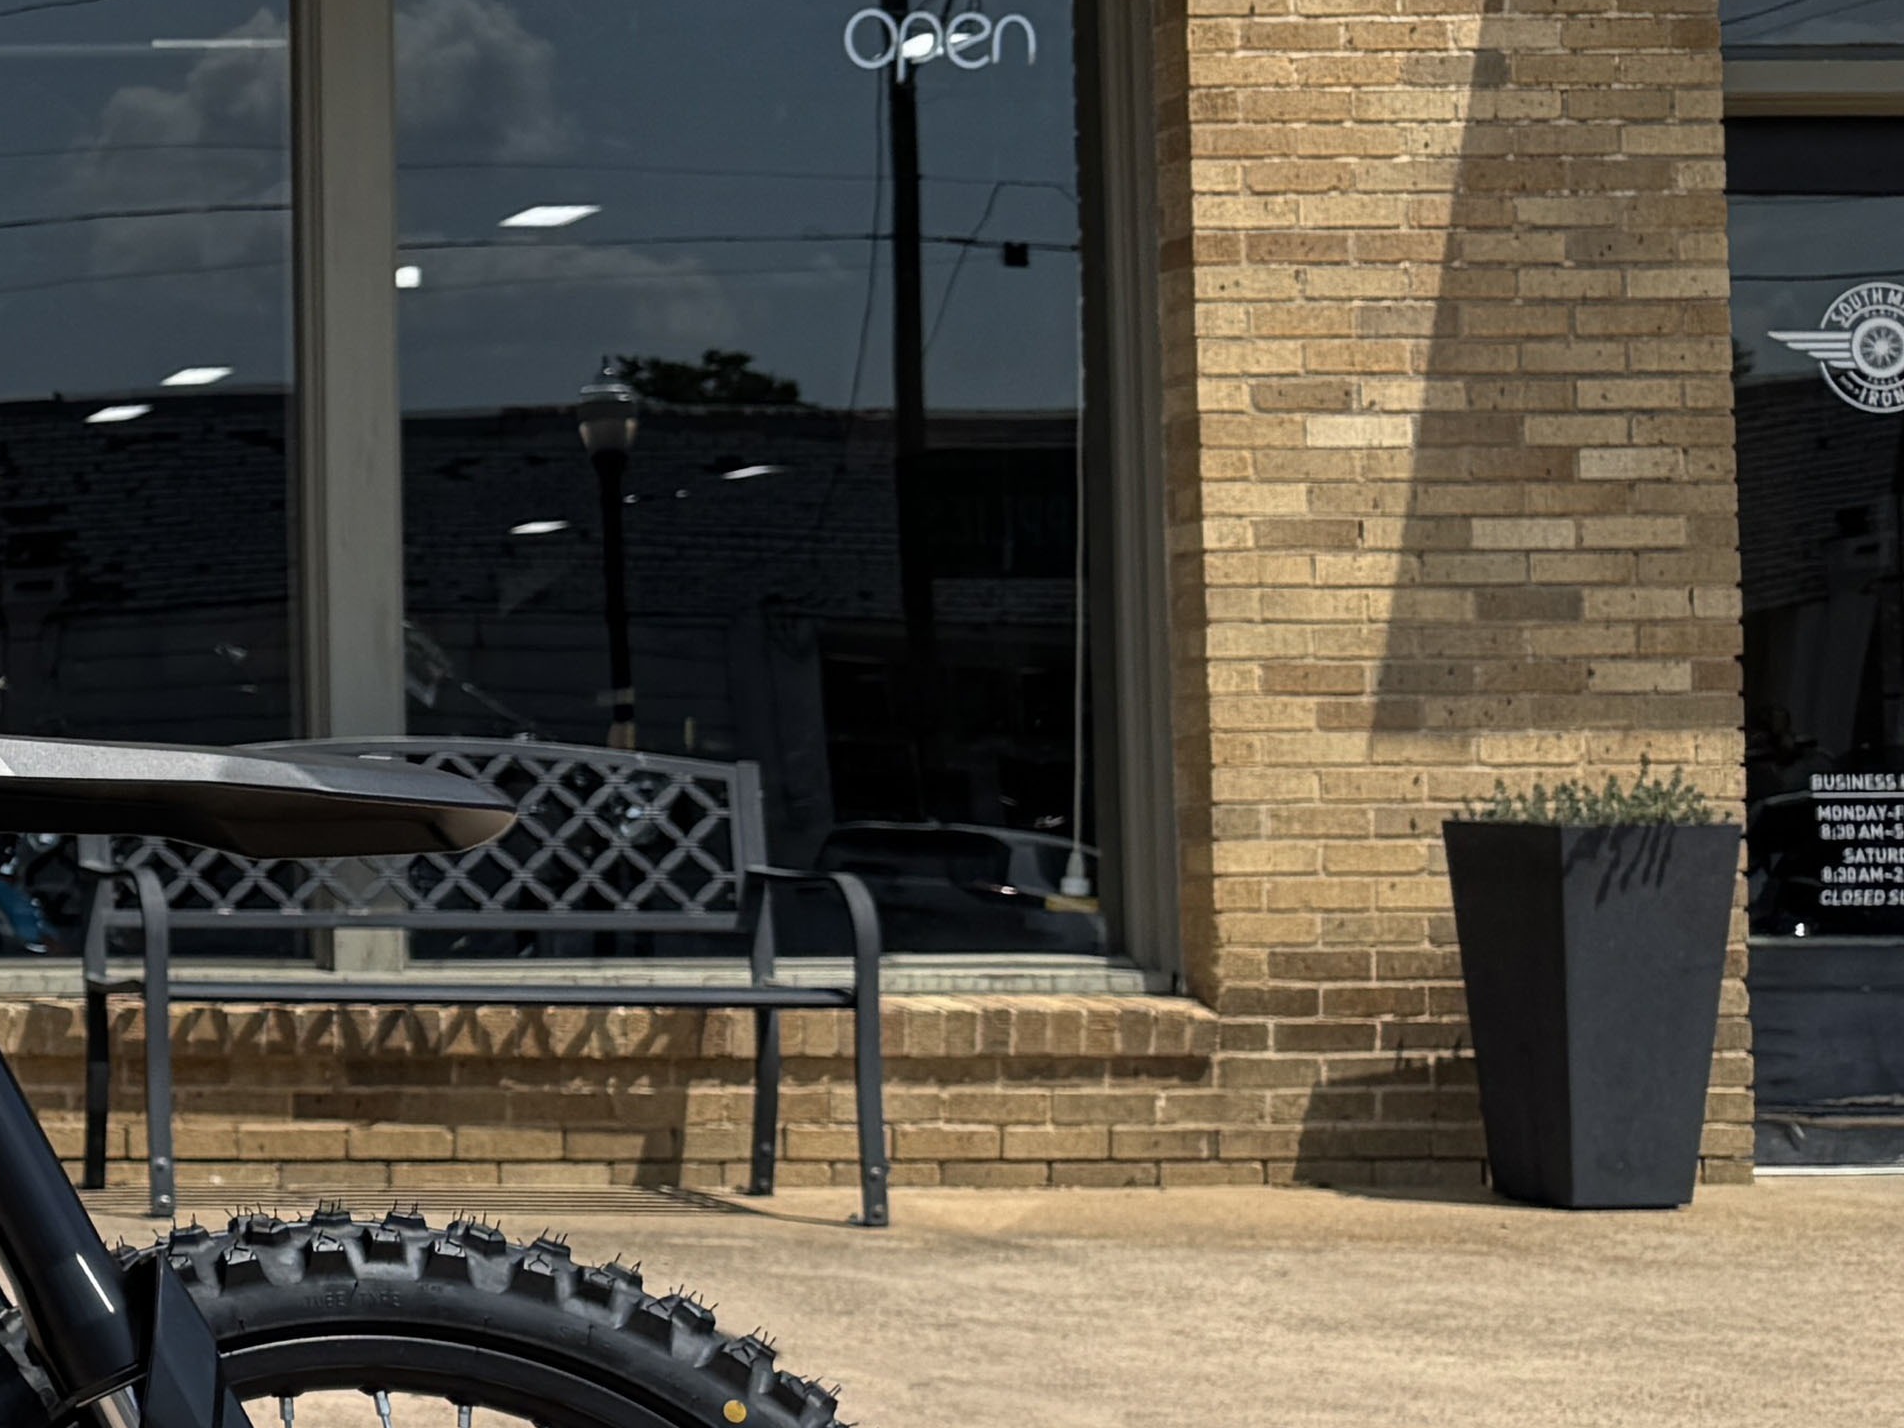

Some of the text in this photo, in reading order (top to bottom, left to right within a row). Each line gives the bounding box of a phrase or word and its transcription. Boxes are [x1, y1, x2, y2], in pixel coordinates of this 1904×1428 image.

[1831, 288, 1883, 328] SOUTH
[1810, 773, 1896, 791] BUSINESS
[1819, 889, 1886, 906] CLOSED
